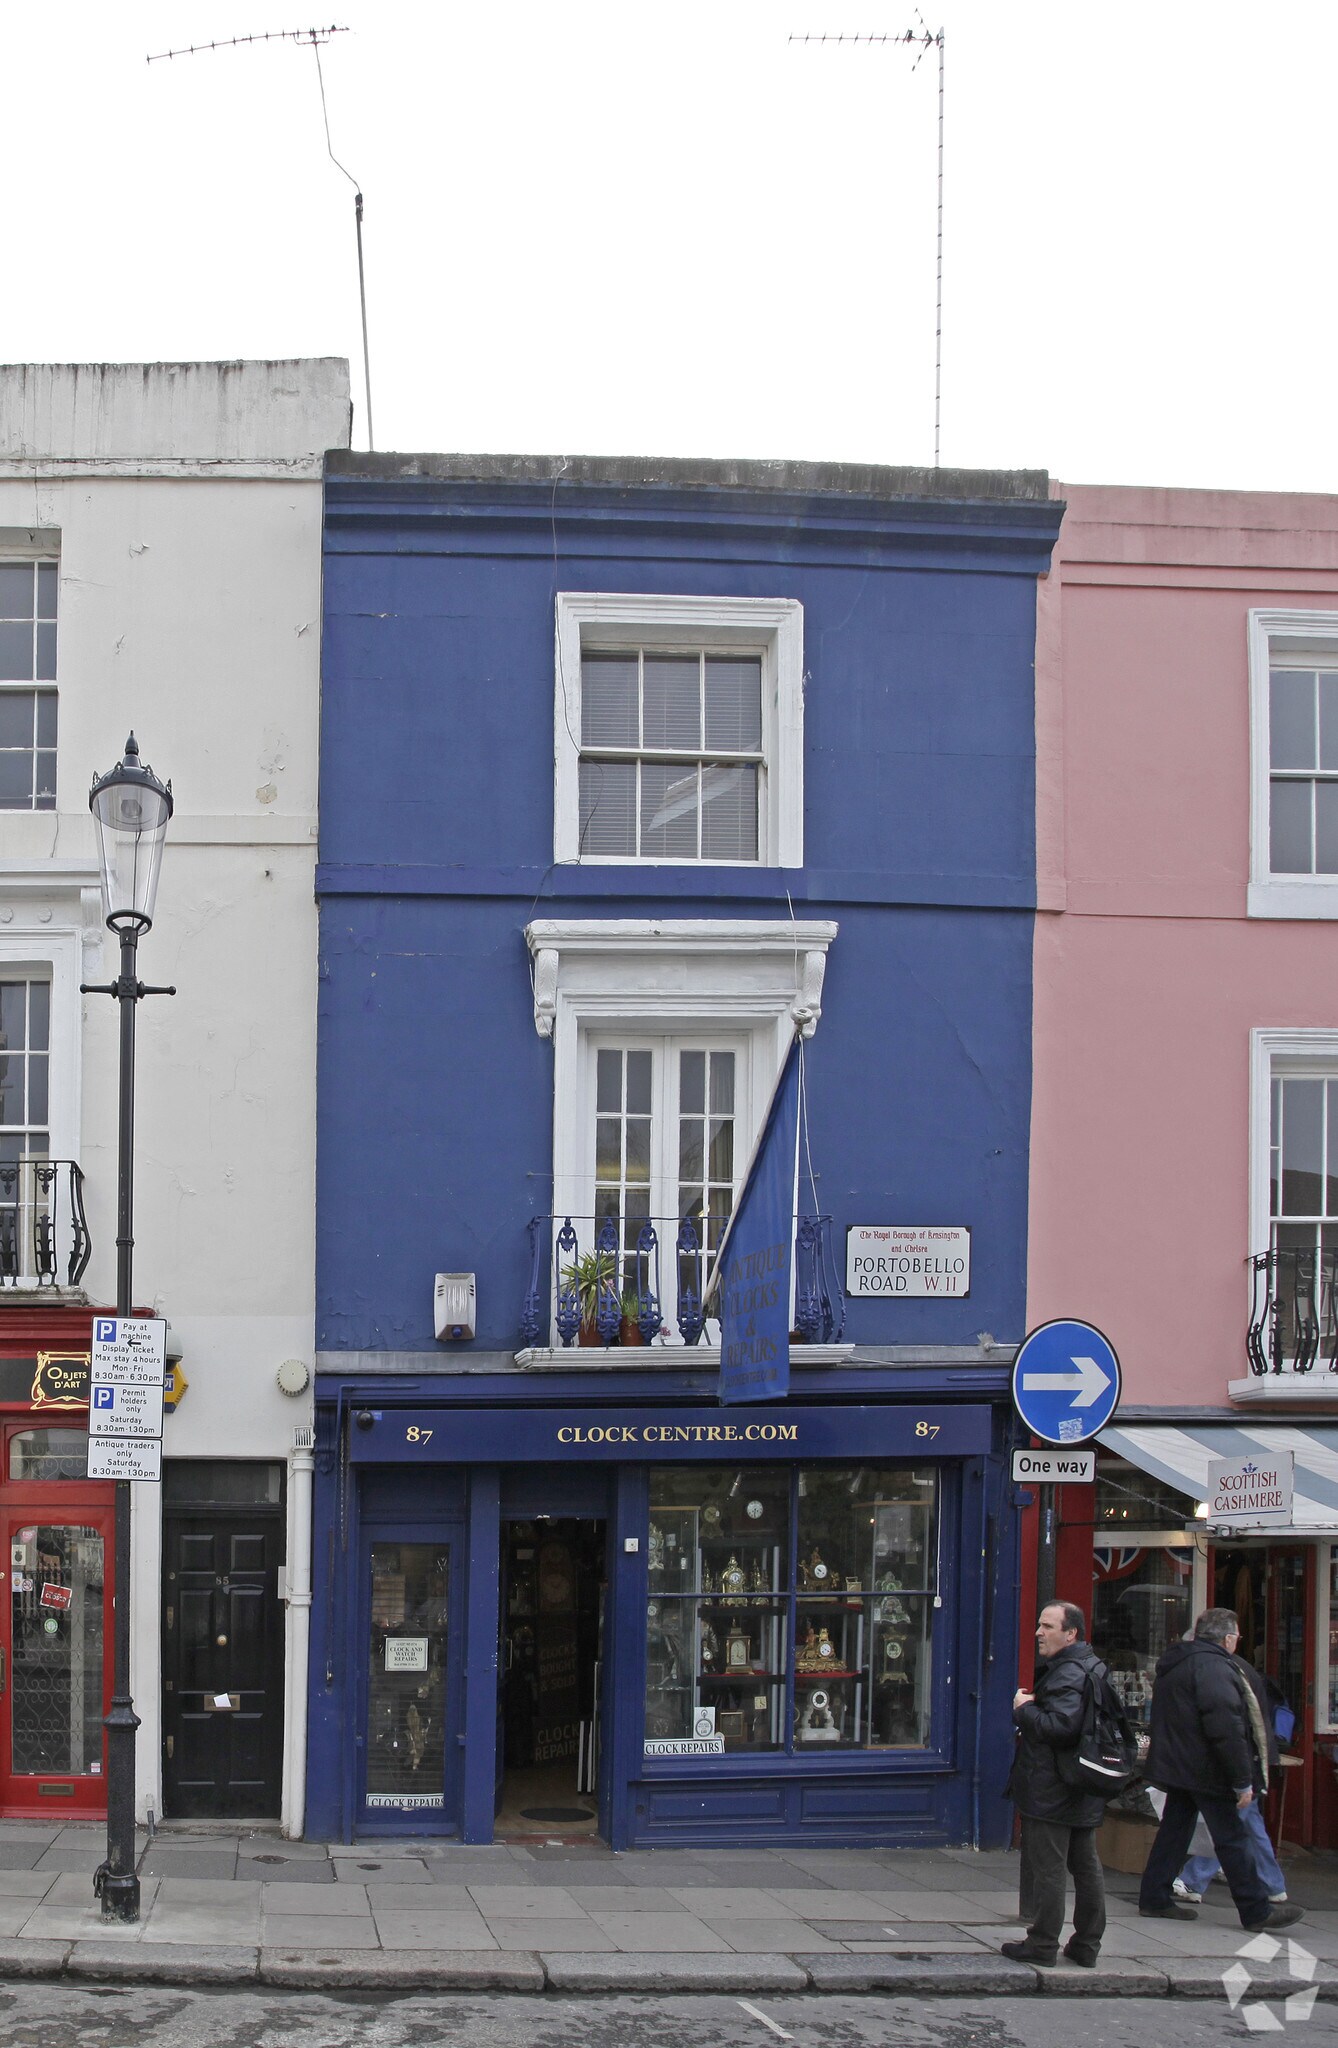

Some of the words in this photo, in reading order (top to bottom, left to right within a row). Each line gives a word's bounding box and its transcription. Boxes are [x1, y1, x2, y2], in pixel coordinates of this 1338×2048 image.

[860, 1231, 871, 1240] The
[874, 1231, 890, 1241] Royal
[893, 1231, 916, 1241] Borough
[919, 1231, 926, 1240] of
[928, 1230, 960, 1241] Kensington
[891, 1245, 901, 1253] and
[904, 1245, 928, 1253] Chelsea
[730, 1243, 786, 1284] ANTIQUE
[854, 1257, 965, 1273] PORTOBELLO
[730, 1280, 779, 1318] CLOCKS
[100, 1322, 113, 1340] P
[123, 1323, 136, 1332] Pay
[102, 1345, 130, 1353] Display
[727, 1337, 778, 1368] REPAIRS
[95, 1354, 111, 1362] Max
[47, 1366, 88, 1381] OBJETS
[112, 1364, 128, 1372] Mon
[54, 1381, 81, 1389] D'ART
[97, 1389, 110, 1407] P
[122, 1389, 146, 1397] Permit
[120, 1397, 147, 1405] holders
[110, 1416, 143, 1424] Saturday
[406, 1425, 434, 1445] 87
[557, 1426, 638, 1443] CLOCK
[643, 1425, 798, 1441] CENTRE.COM
[915, 1421, 941, 1440] 87
[95, 1440, 125, 1449] Antique
[127, 1442, 155, 1450] traders
[116, 1450, 133, 1458] only
[107, 1459, 142, 1468] Saturday
[1019, 1457, 1051, 1473] One
[1057, 1461, 1088, 1476] way
[1219, 1471, 1277, 1491] SCOTTISH
[1214, 1491, 1283, 1511] CASHMERE
[537, 1722, 580, 1745] CLOCK
[645, 1743, 679, 1755] CLOCK
[681, 1742, 720, 1754] REPAIRS
[371, 1798, 405, 1807] CLOCK
